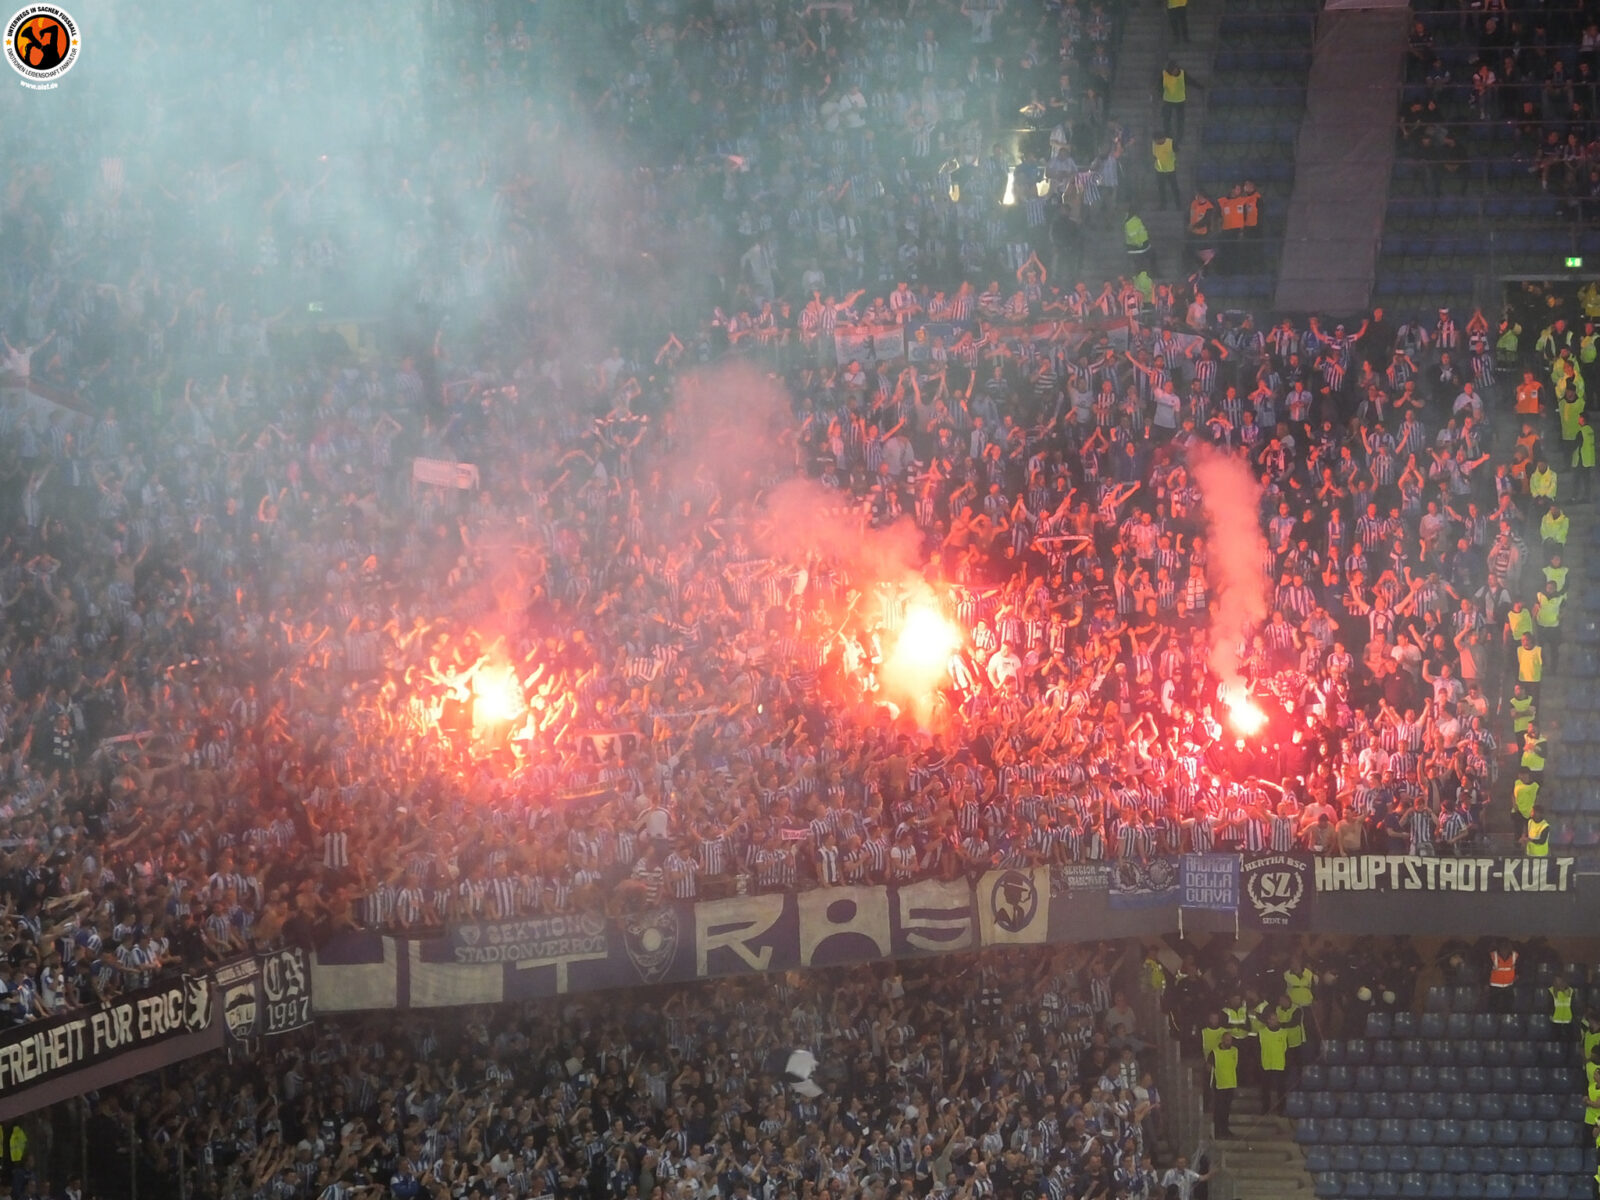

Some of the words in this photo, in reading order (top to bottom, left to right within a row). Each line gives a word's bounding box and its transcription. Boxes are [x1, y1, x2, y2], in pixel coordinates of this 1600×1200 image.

[1244, 855, 1285, 872] HERTHA
[1286, 857, 1307, 871] BSC
[1314, 855, 1575, 892] HAUPTSTADT-KULT
[1185, 872, 1233, 888] DELLA
[1260, 872, 1292, 898] SZ
[486, 914, 580, 943] SEKTION
[454, 935, 606, 964] STADIONVERBOT
[266, 996, 309, 1031] 1997
[0, 1019, 87, 1090] FREIHEIT
[91, 1001, 133, 1055] FÜR
[137, 989, 183, 1040] ERIC
